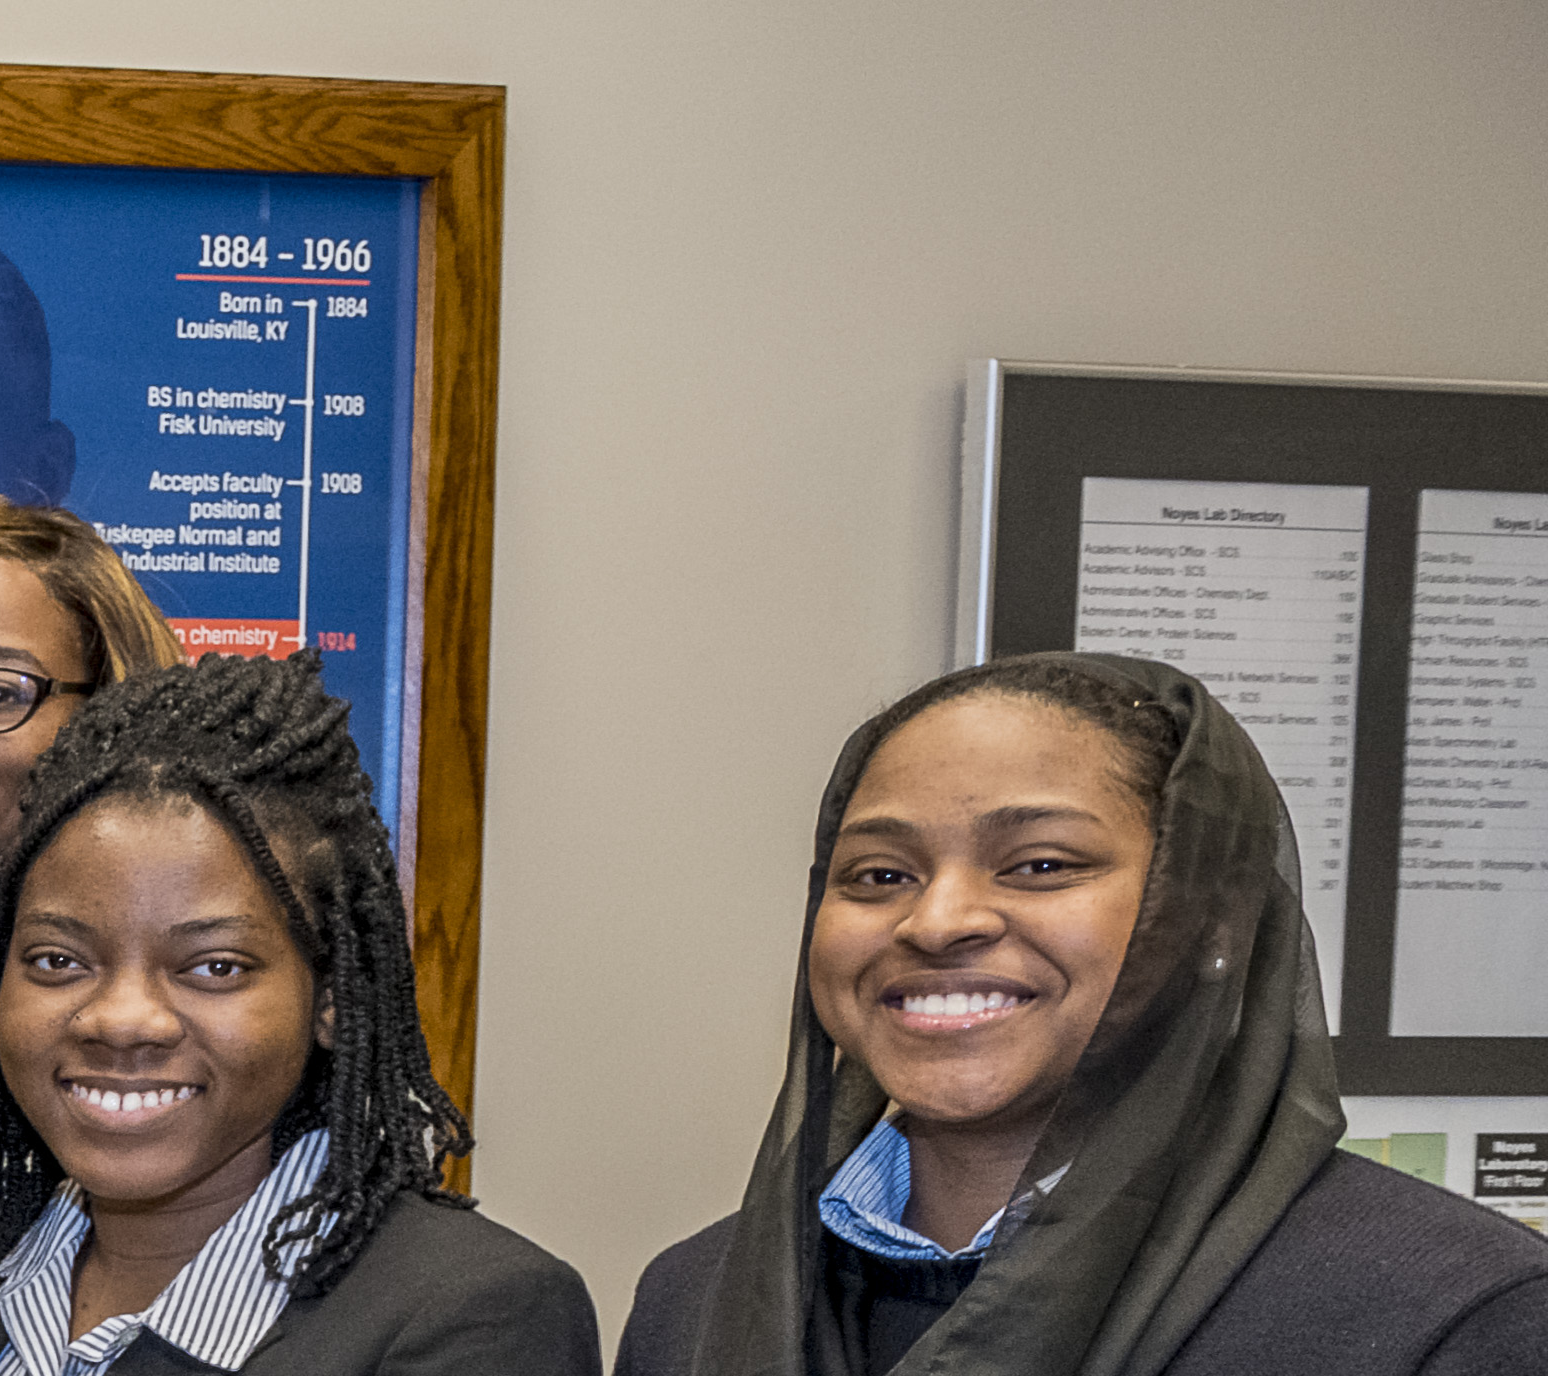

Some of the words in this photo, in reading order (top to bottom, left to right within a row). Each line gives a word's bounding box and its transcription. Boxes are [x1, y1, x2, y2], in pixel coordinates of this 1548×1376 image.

[198, 235, 267, 270] 1884
[302, 237, 372, 272] 1966
[219, 293, 261, 314] Born
[265, 293, 283, 314] in
[327, 297, 366, 317] 1884
[177, 319, 262, 343] Louisville,
[266, 320, 288, 341] KY
[148, 386, 172, 407] BS
[175, 387, 193, 408] in
[196, 387, 286, 415] chemistry
[324, 396, 364, 415] 1908
[159, 413, 194, 434] Fisk
[199, 414, 285, 441] University
[149, 471, 218, 497] Accepts
[223, 472, 283, 498] faculty
[321, 474, 362, 493] 1908
[189, 499, 259, 525] position
[264, 500, 282, 520] at
[1161, 506, 1200, 524] Noyes
[1204, 507, 1226, 522] Lab
[1230, 508, 1286, 526] Directory
[179, 525, 242, 547] Normal
[246, 526, 280, 547] and
[123, 550, 204, 572] Industrial
[209, 551, 280, 573] Institute
[190, 625, 278, 650] chemistry
[317, 632, 356, 651] 1914
